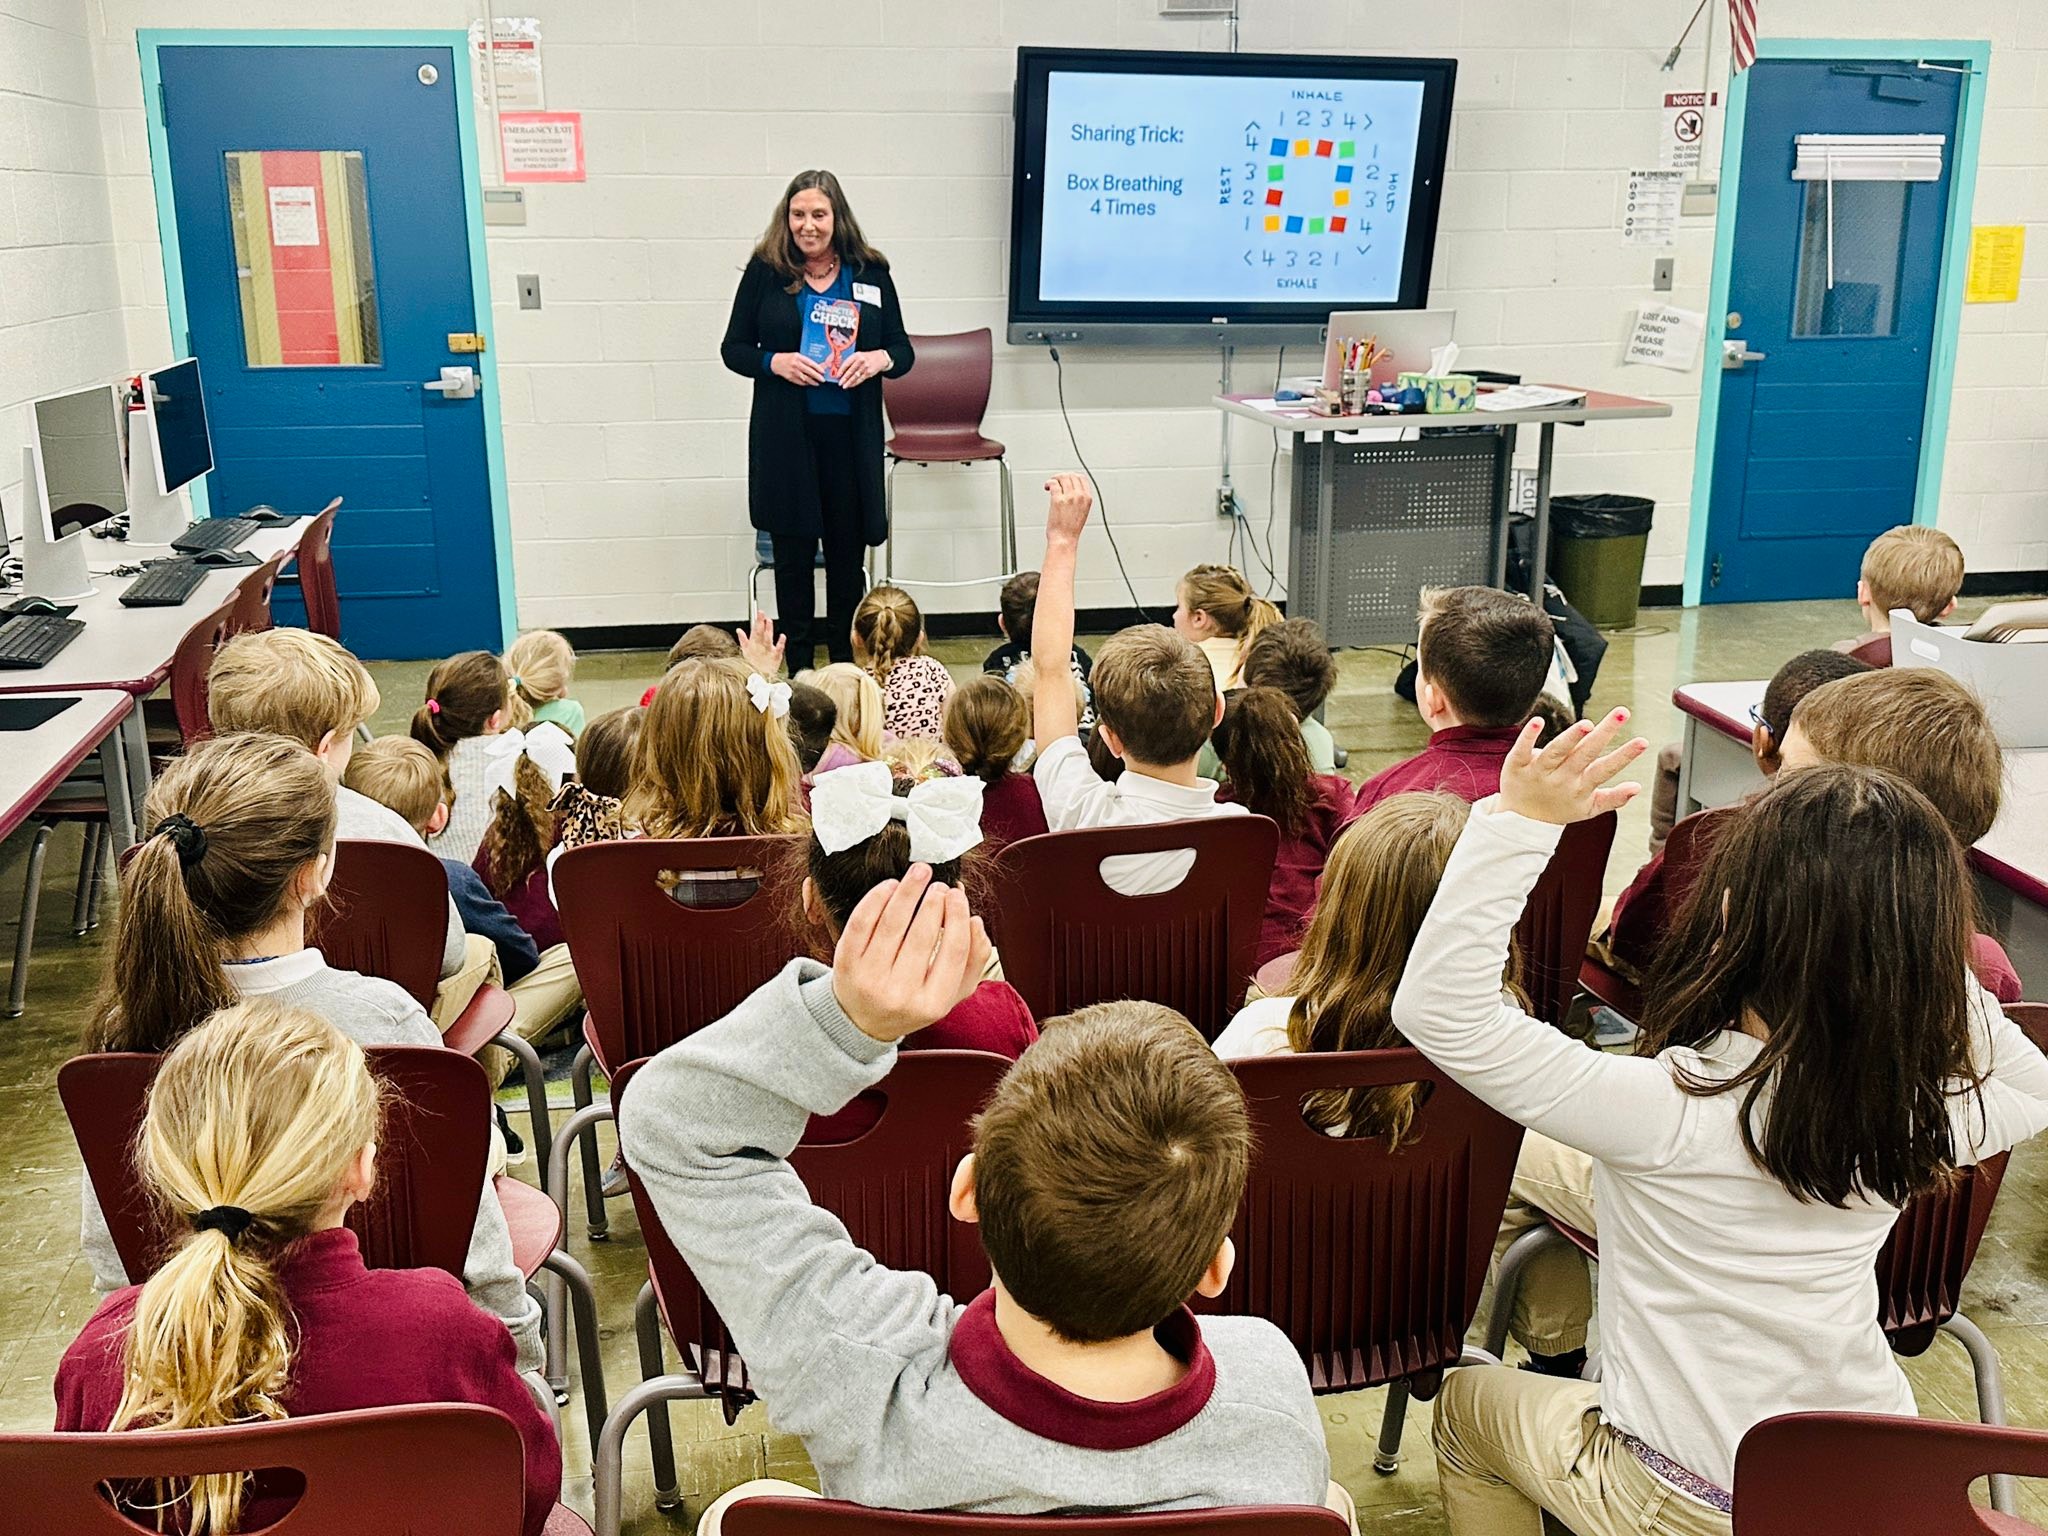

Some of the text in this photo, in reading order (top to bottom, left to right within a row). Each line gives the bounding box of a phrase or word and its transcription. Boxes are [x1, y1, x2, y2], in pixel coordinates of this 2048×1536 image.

[1291, 90, 1343, 101] INHALE
[1672, 95, 1706, 106] NOTIC
[1296, 110, 1311, 126] 2
[1321, 110, 1333, 128] 3
[1344, 113, 1356, 131] 4
[1071, 124, 1184, 146] Sharing Trick:
[1246, 133, 1259, 152] 4
[1245, 162, 1257, 180] 3
[1366, 164, 1380, 180] 2
[1067, 173, 1183, 196] Box Breathing
[1219, 166, 1231, 205] REST
[1386, 173, 1399, 213] HOLD
[1242, 189, 1254, 206] 2
[1365, 190, 1377, 208] 3
[1090, 198, 1156, 216] 4 Times
[1360, 218, 1372, 235] 4
[1262, 249, 1275, 267] 4
[1286, 250, 1298, 267] 3
[1308, 251, 1322, 266] 2
[1277, 278, 1318, 289] EXHALE
[810, 310, 857, 329] CHECK
[1642, 312, 1681, 325] LOST AND
[1635, 334, 1664, 346] PLEASE
